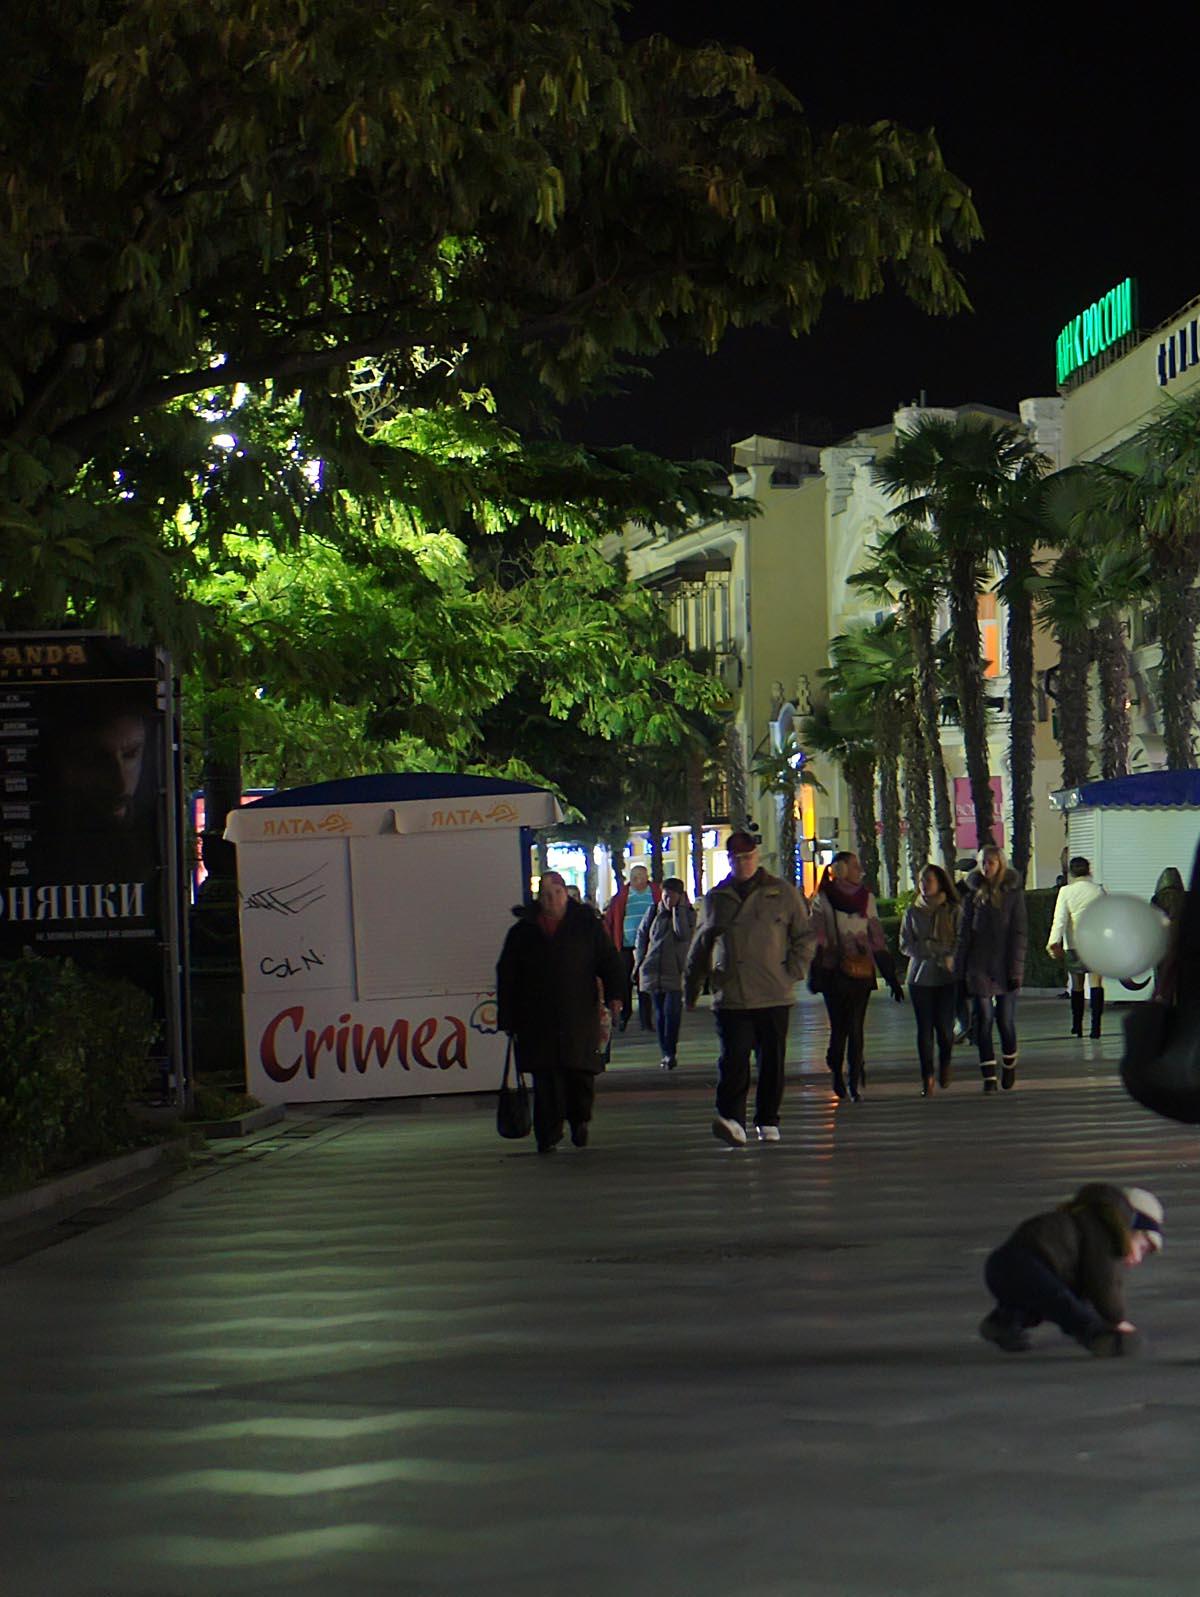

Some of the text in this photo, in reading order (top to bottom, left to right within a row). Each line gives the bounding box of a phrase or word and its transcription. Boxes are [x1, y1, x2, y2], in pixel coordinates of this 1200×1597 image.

[1083, 277, 1132, 362] РОССИИ
[263, 817, 316, 836] ЯЛТА
[431, 808, 484, 827] ЯЛТА
[259, 1005, 468, 1083] Crimea
